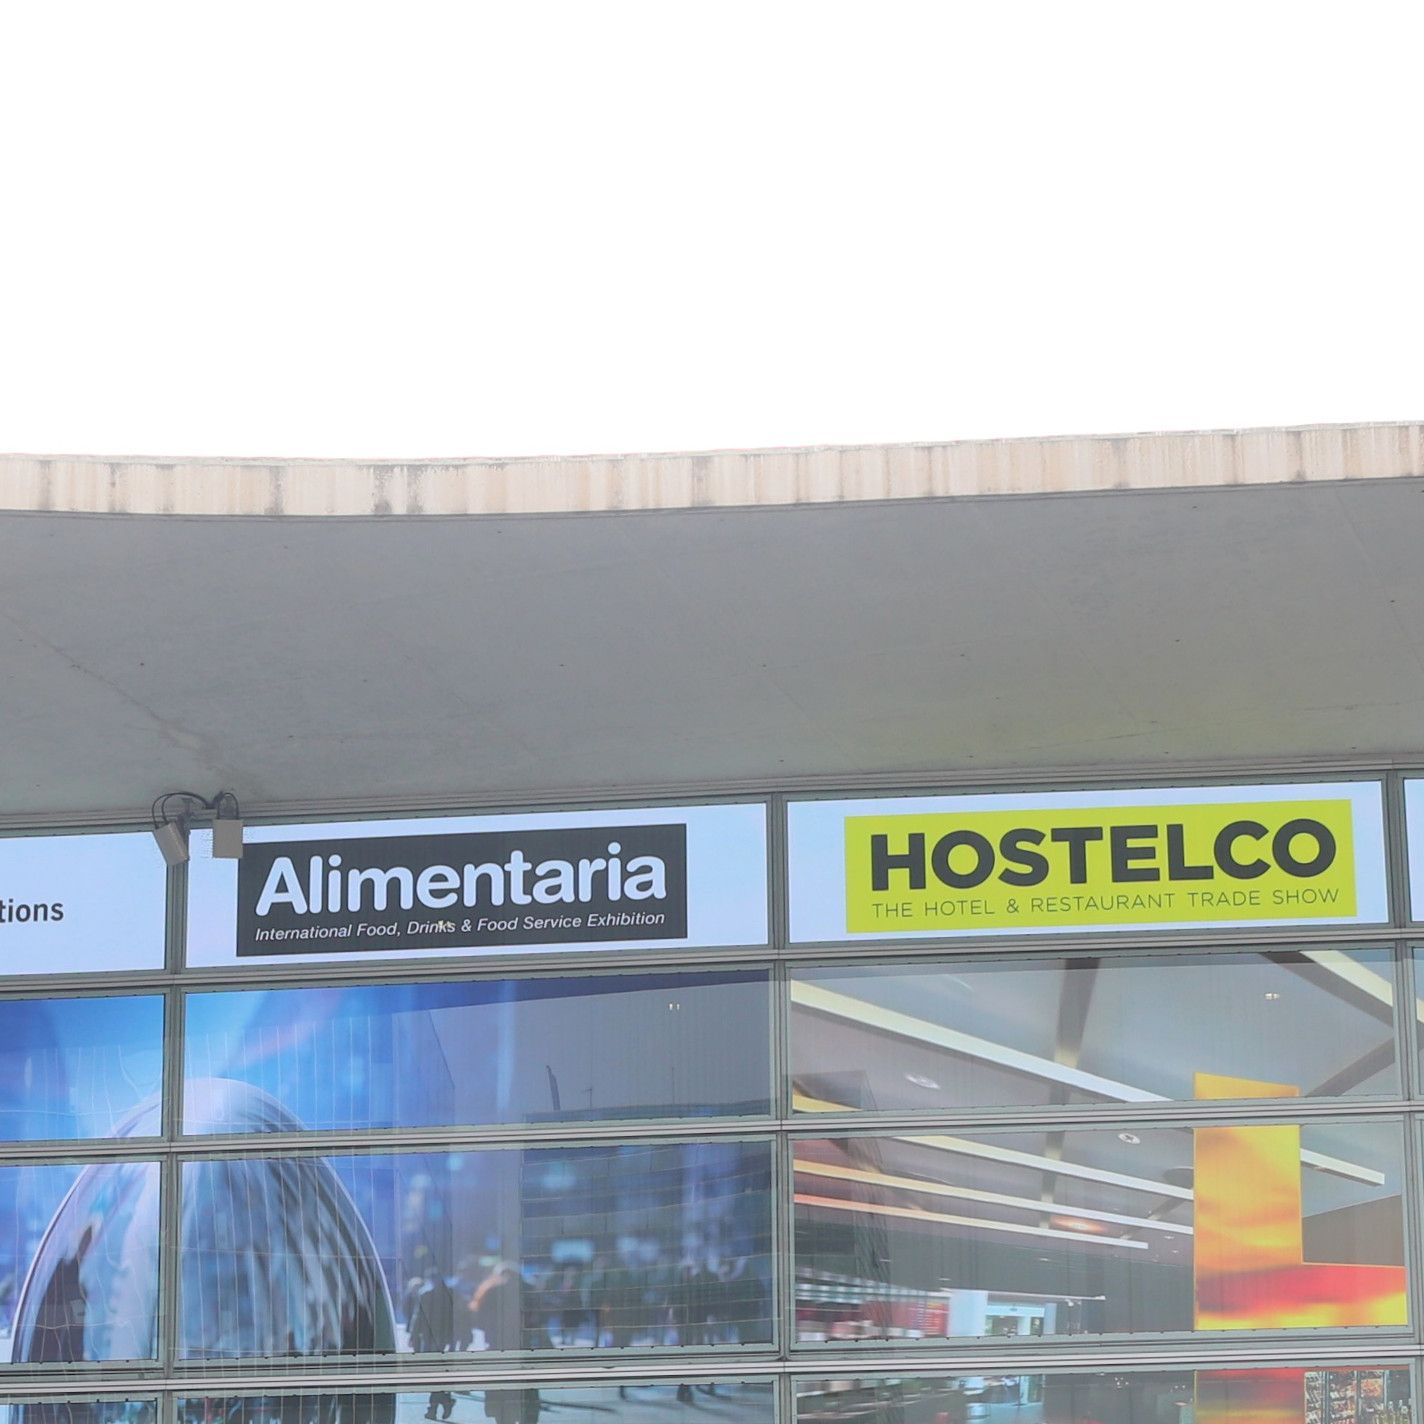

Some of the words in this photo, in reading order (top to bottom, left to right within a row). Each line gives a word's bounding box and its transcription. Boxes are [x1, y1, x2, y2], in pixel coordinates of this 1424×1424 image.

[255, 842, 666, 917] Alimentaria
[871, 818, 1336, 892] HOSTELCO
[255, 924, 351, 942] International
[356, 921, 400, 939] Food,
[407, 919, 455, 935] Drinks
[462, 918, 472, 933] &
[478, 916, 518, 932] Food
[523, 914, 581, 930] Service
[587, 911, 665, 928] Exhibition
[872, 902, 913, 918] THE
[925, 899, 995, 917] HOTEL
[1006, 898, 1020, 914] &
[1031, 893, 1176, 913] RESTAURANT
[1188, 890, 1261, 908] TRADE
[1272, 887, 1340, 905] SHOW
